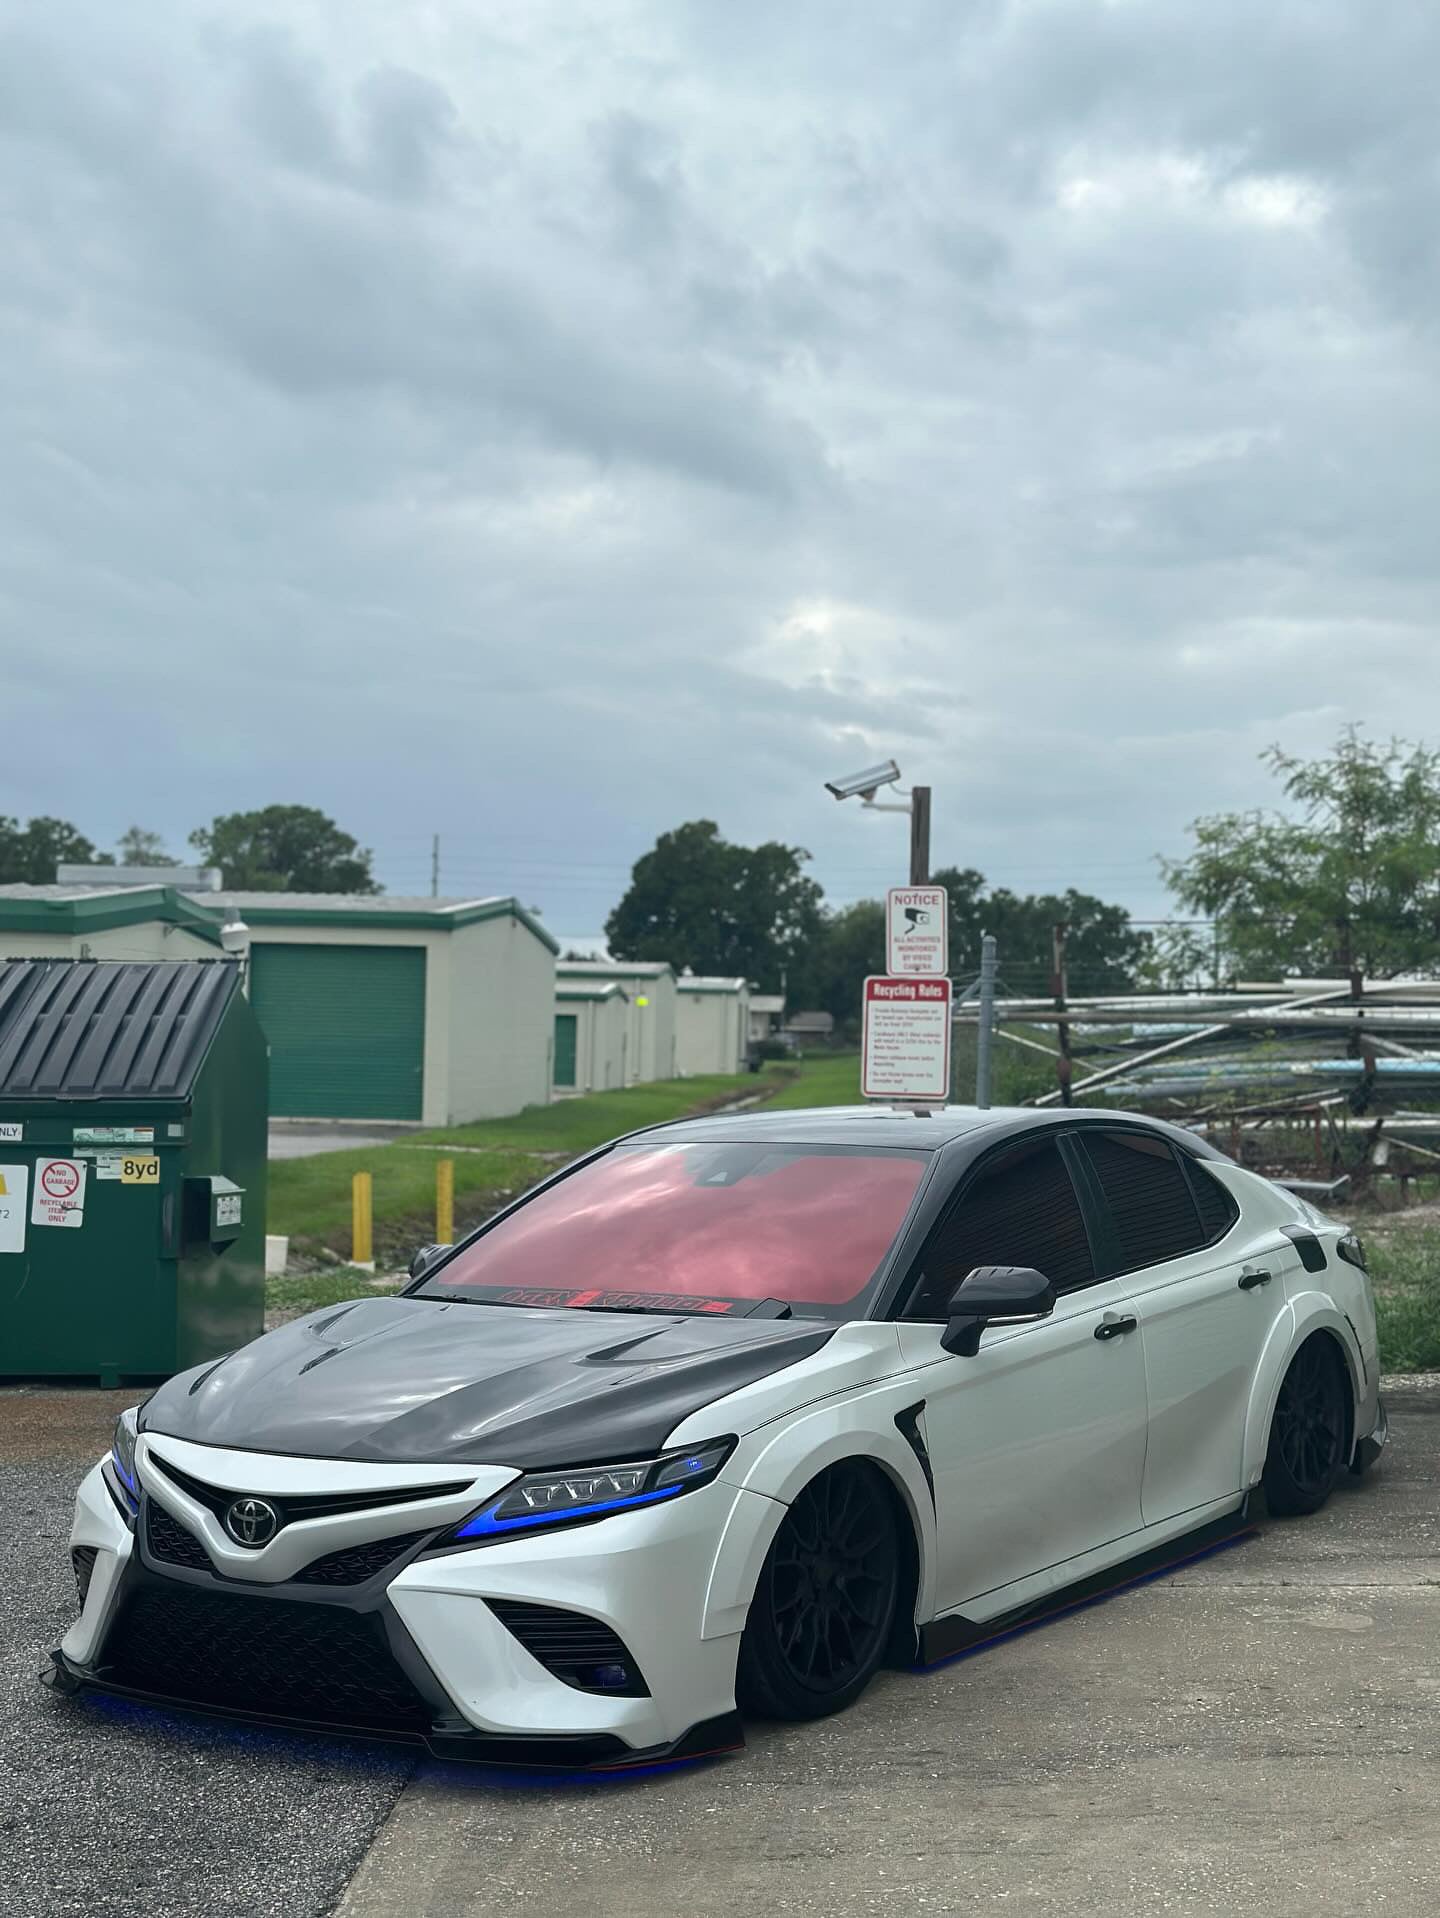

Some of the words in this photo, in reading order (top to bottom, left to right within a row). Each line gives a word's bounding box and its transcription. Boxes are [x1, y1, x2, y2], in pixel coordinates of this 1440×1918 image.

[894, 894, 940, 905] NOTICE
[873, 983, 916, 999] Recycling
[918, 984, 943, 997] Rules
[0, 1127, 18, 1137] NLY
[123, 1161, 158, 1180] 8yd
[46, 1178, 75, 1186] GARBAGE
[39, 1199, 77, 1208] RECYCLABLE
